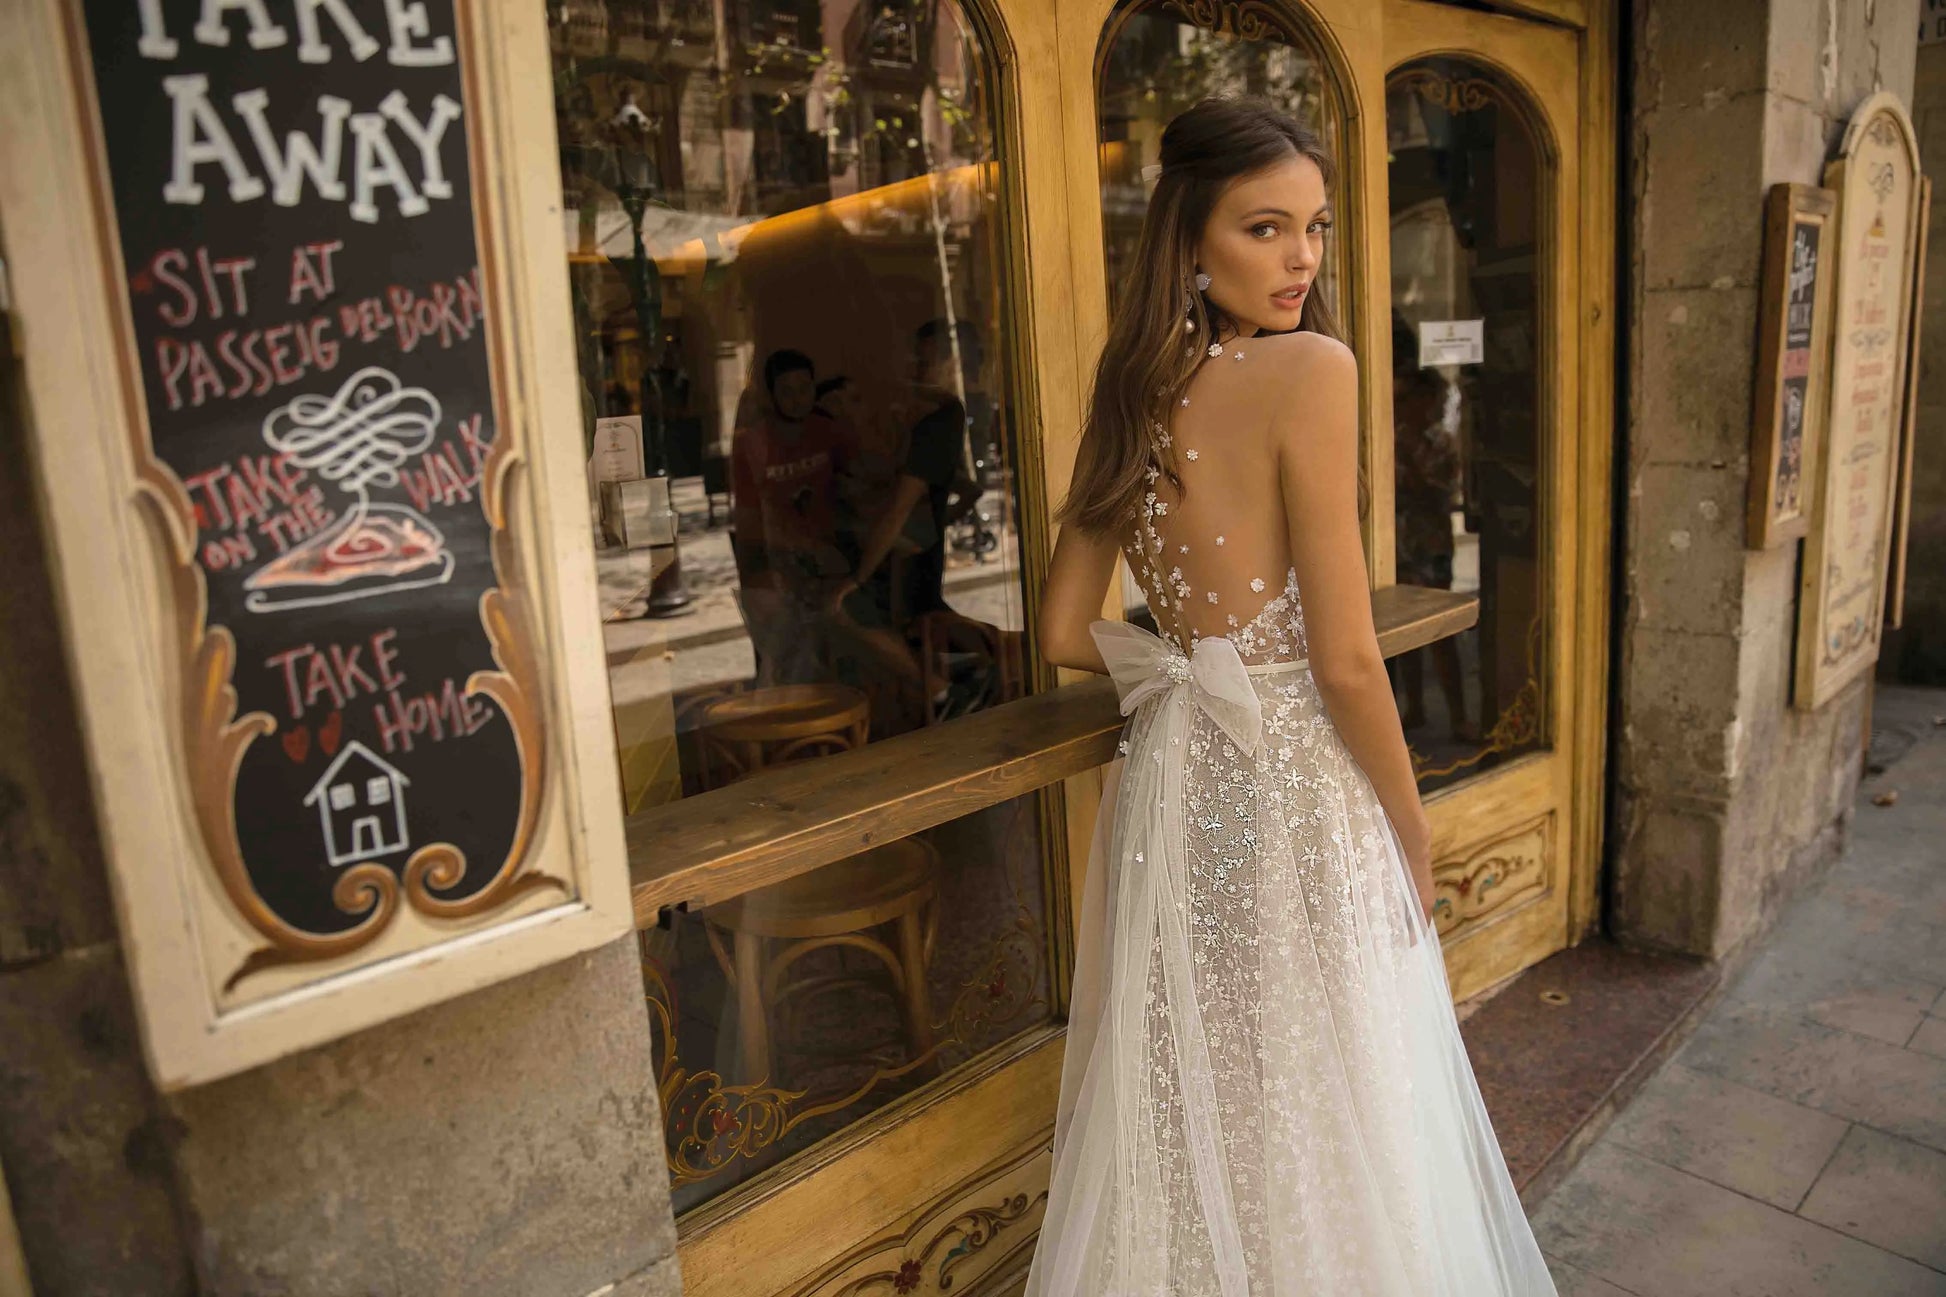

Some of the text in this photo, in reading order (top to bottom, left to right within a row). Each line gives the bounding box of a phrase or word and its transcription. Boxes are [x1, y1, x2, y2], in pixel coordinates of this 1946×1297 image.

[162, 73, 462, 224] AWAY
[152, 239, 344, 328] SIT AT
[156, 265, 484, 411] PASSEIG DEL BORN
[185, 450, 309, 530] TAKE
[400, 413, 494, 512] WALK
[203, 485, 335, 570] ON THE
[265, 627, 406, 719] TAKE
[374, 679, 493, 753] HOME
